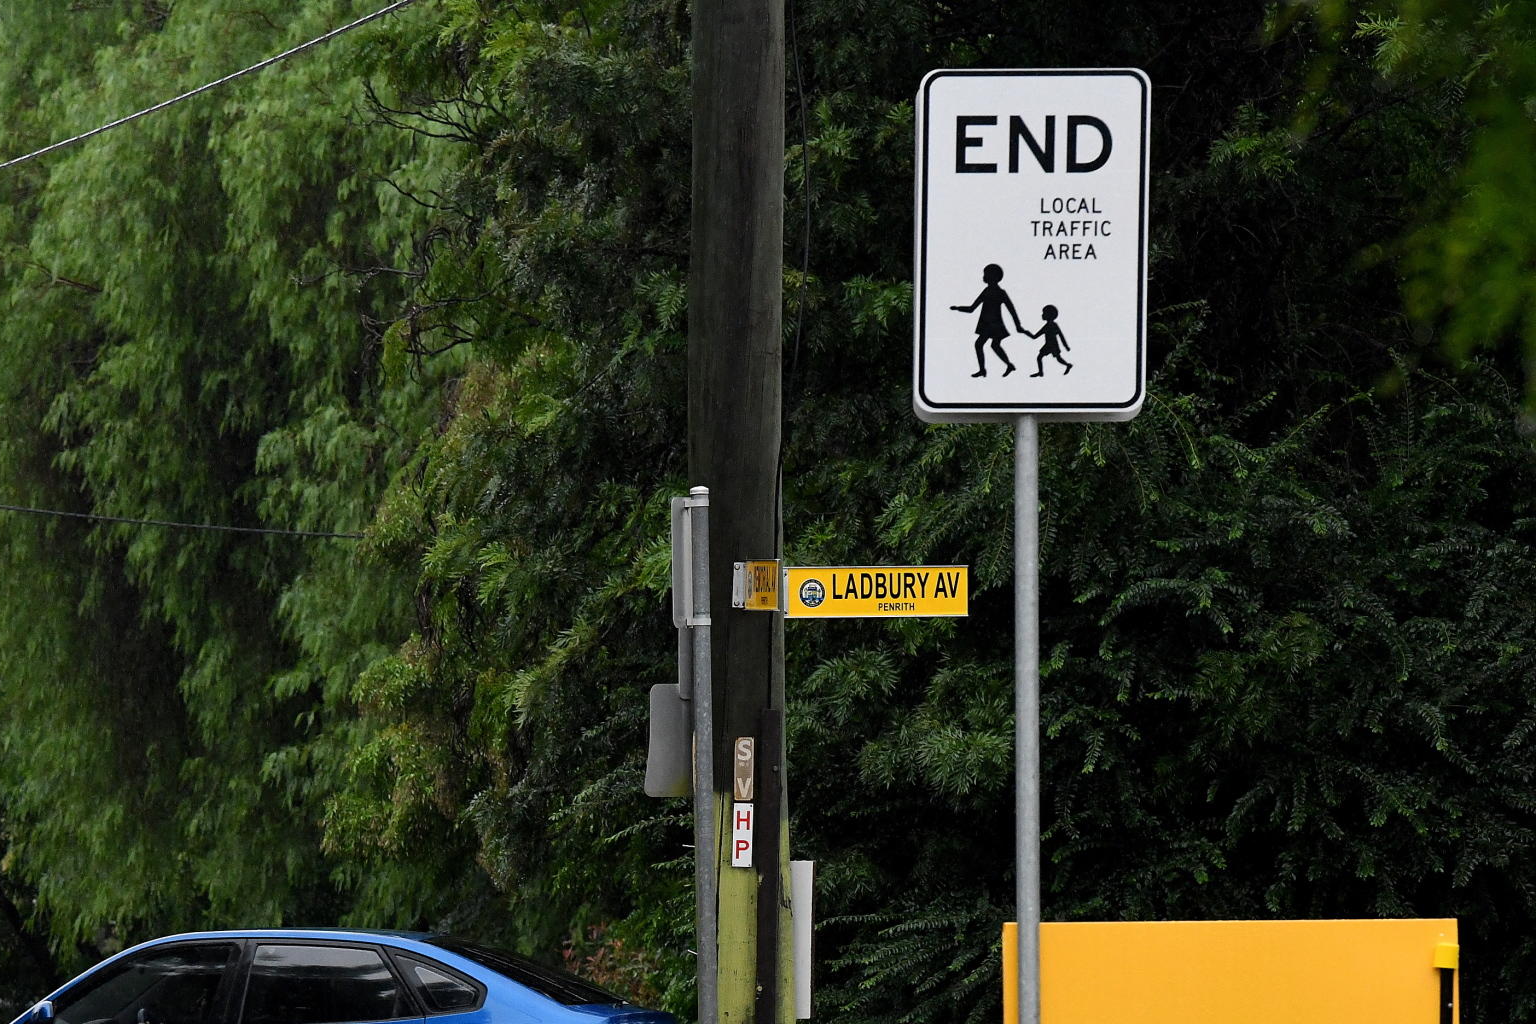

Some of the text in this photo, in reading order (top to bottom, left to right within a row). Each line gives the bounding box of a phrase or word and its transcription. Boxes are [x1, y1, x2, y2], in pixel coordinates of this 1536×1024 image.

[955, 114, 1113, 174] END
[1040, 197, 1102, 214] LOCAL
[1030, 220, 1112, 237] TRAFFIC
[1043, 243, 1097, 260] AREA
[832, 572, 930, 600] LADBURY
[933, 571, 961, 599] AV
[878, 602, 915, 612] PENRITH
